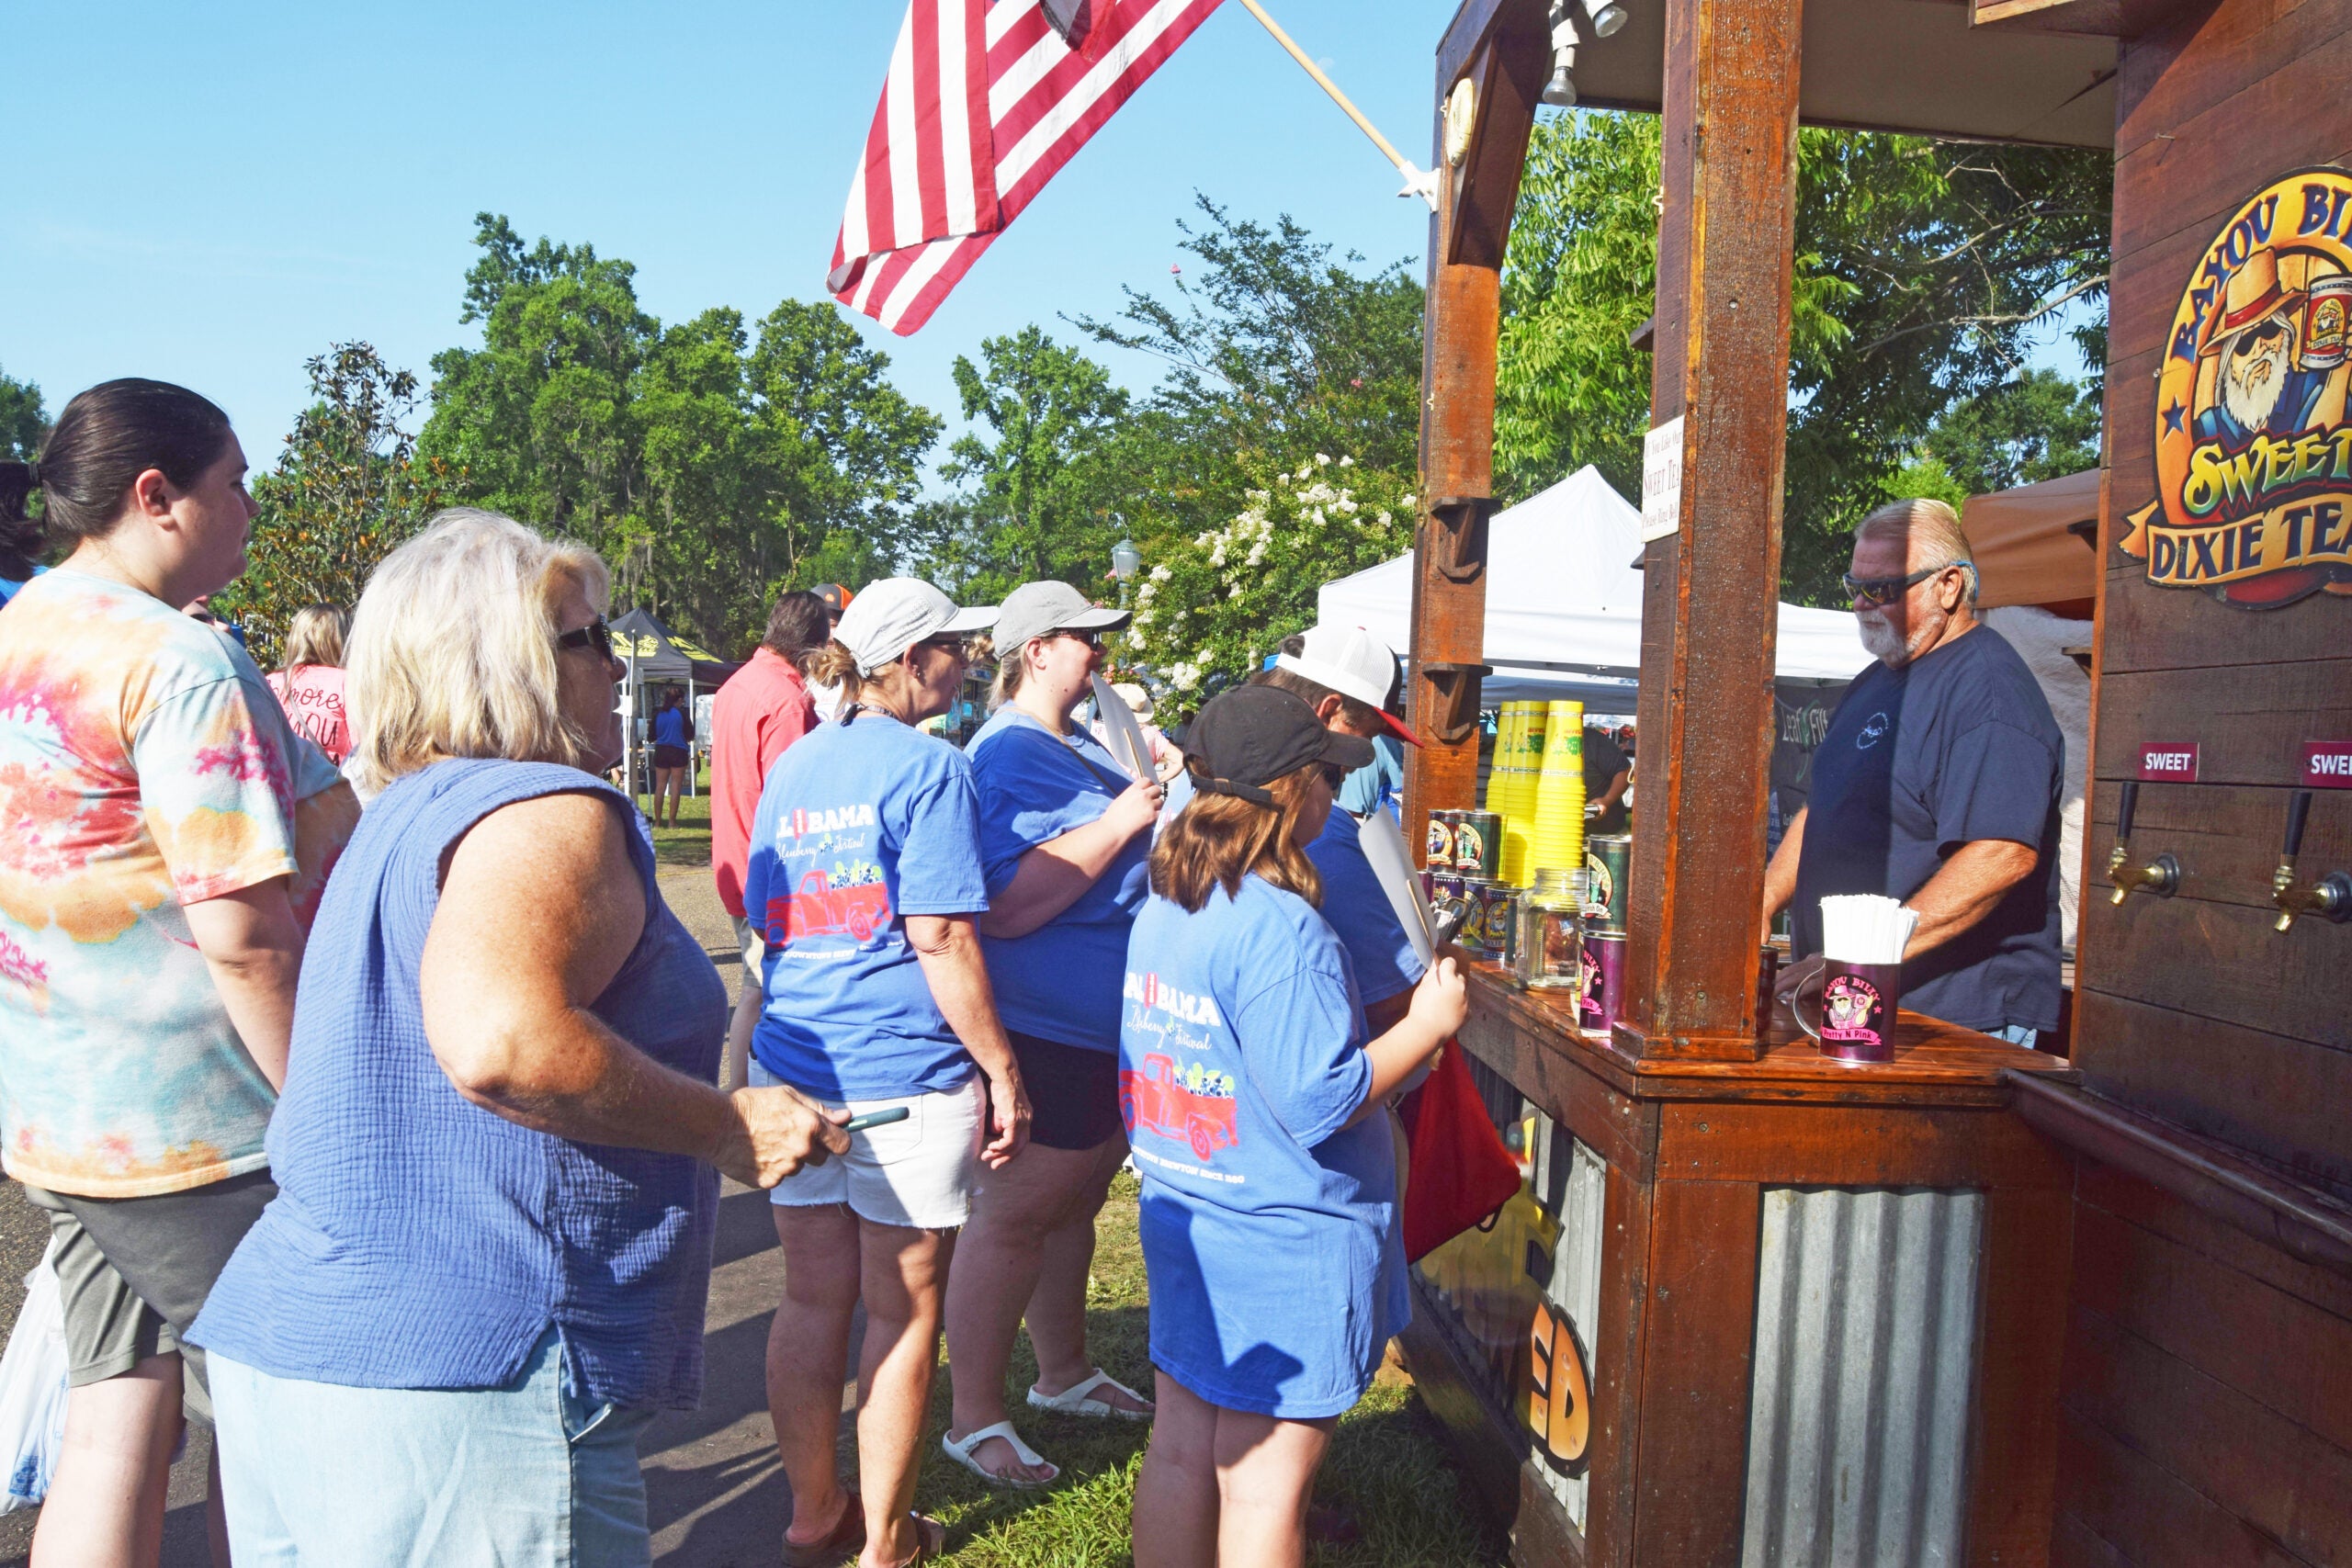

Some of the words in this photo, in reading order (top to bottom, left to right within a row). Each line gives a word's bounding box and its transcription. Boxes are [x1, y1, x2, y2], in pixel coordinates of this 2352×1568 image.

[2170, 192, 2279, 364] BAYOU
[2297, 182, 2352, 250] BI
[1643, 468, 1666, 500] SWEET
[1668, 459, 1679, 491] TEA
[2184, 427, 2352, 514] SWEET
[2152, 525, 2266, 581] DIXIE
[1781, 706, 1803, 744] Leaf
[2145, 752, 2191, 772] SWEET
[1825, 976, 1848, 1000] BAYOU
[1852, 977, 1881, 1001] BILLY
[1175, 1022, 1212, 1051] Festival
[1824, 1030, 1842, 1041] Pretty
[1854, 1031, 1872, 1040] Pink
